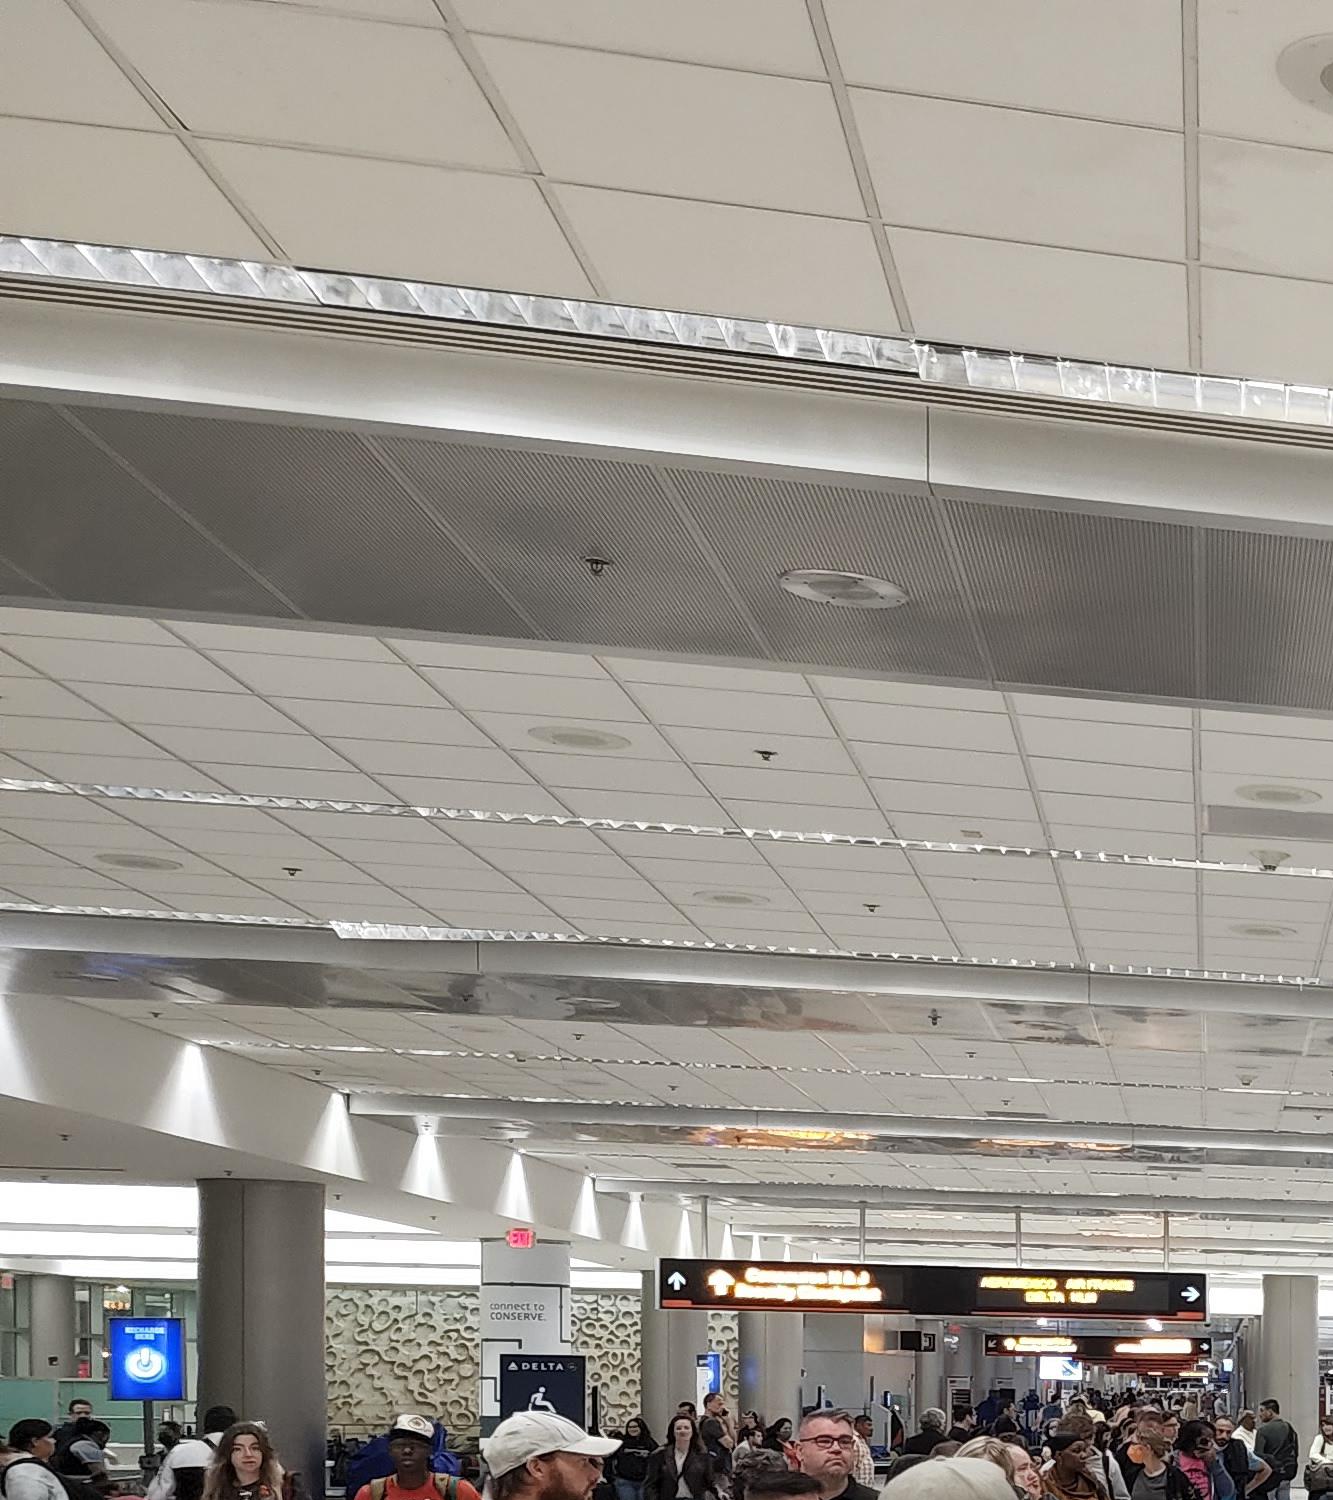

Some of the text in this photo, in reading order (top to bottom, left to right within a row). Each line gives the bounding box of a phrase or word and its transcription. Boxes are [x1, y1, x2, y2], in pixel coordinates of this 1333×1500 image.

[490, 1303, 545, 1311] connect to
[521, 1362, 564, 1371] DELTA
